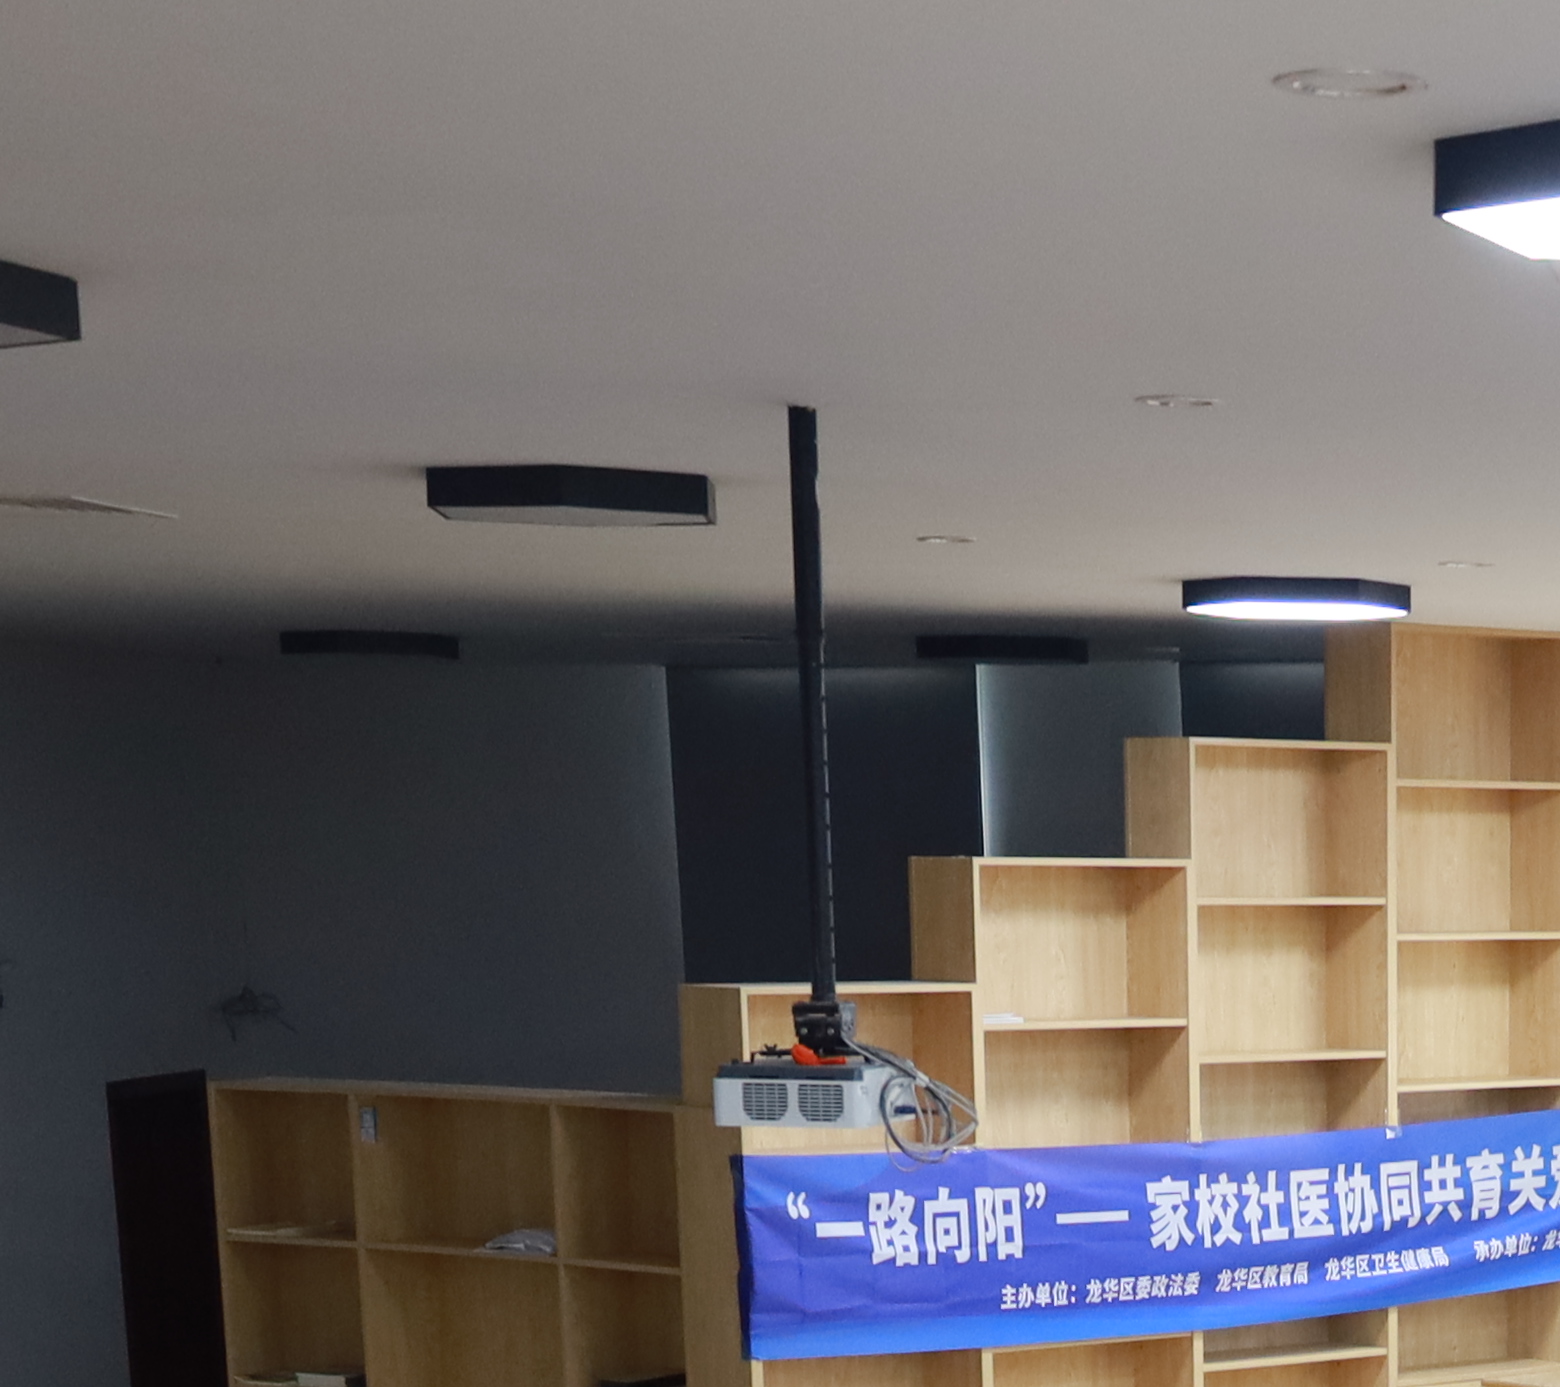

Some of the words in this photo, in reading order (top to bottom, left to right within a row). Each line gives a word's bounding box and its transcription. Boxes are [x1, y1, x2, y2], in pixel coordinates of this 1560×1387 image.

[1215, 1260, 1309, 1293] 龙华区教育局
[1325, 1246, 1450, 1281] 龙华区卫生健康局
